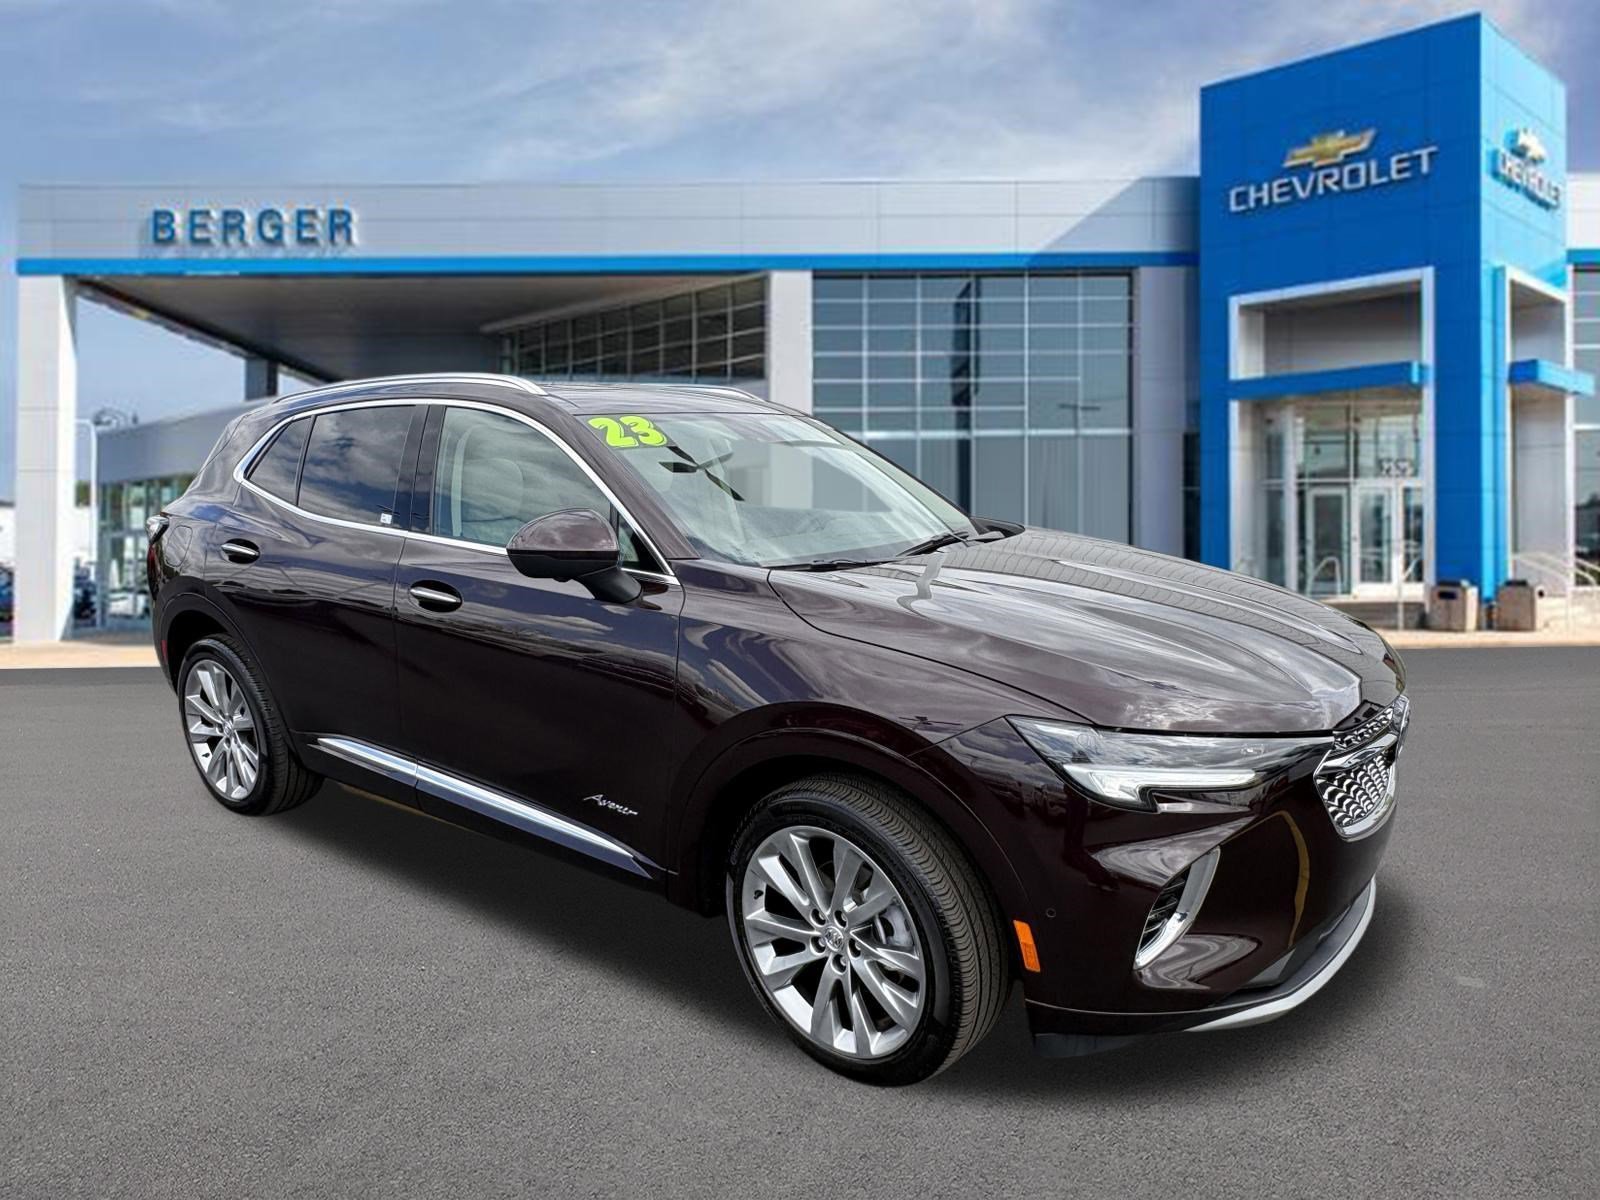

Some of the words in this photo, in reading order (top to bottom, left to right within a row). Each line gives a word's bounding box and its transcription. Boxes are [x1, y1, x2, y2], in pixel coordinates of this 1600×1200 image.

[1229, 146, 1438, 212] CHEVROLET
[152, 208, 357, 245] BERGER
[588, 415, 668, 447] 23
